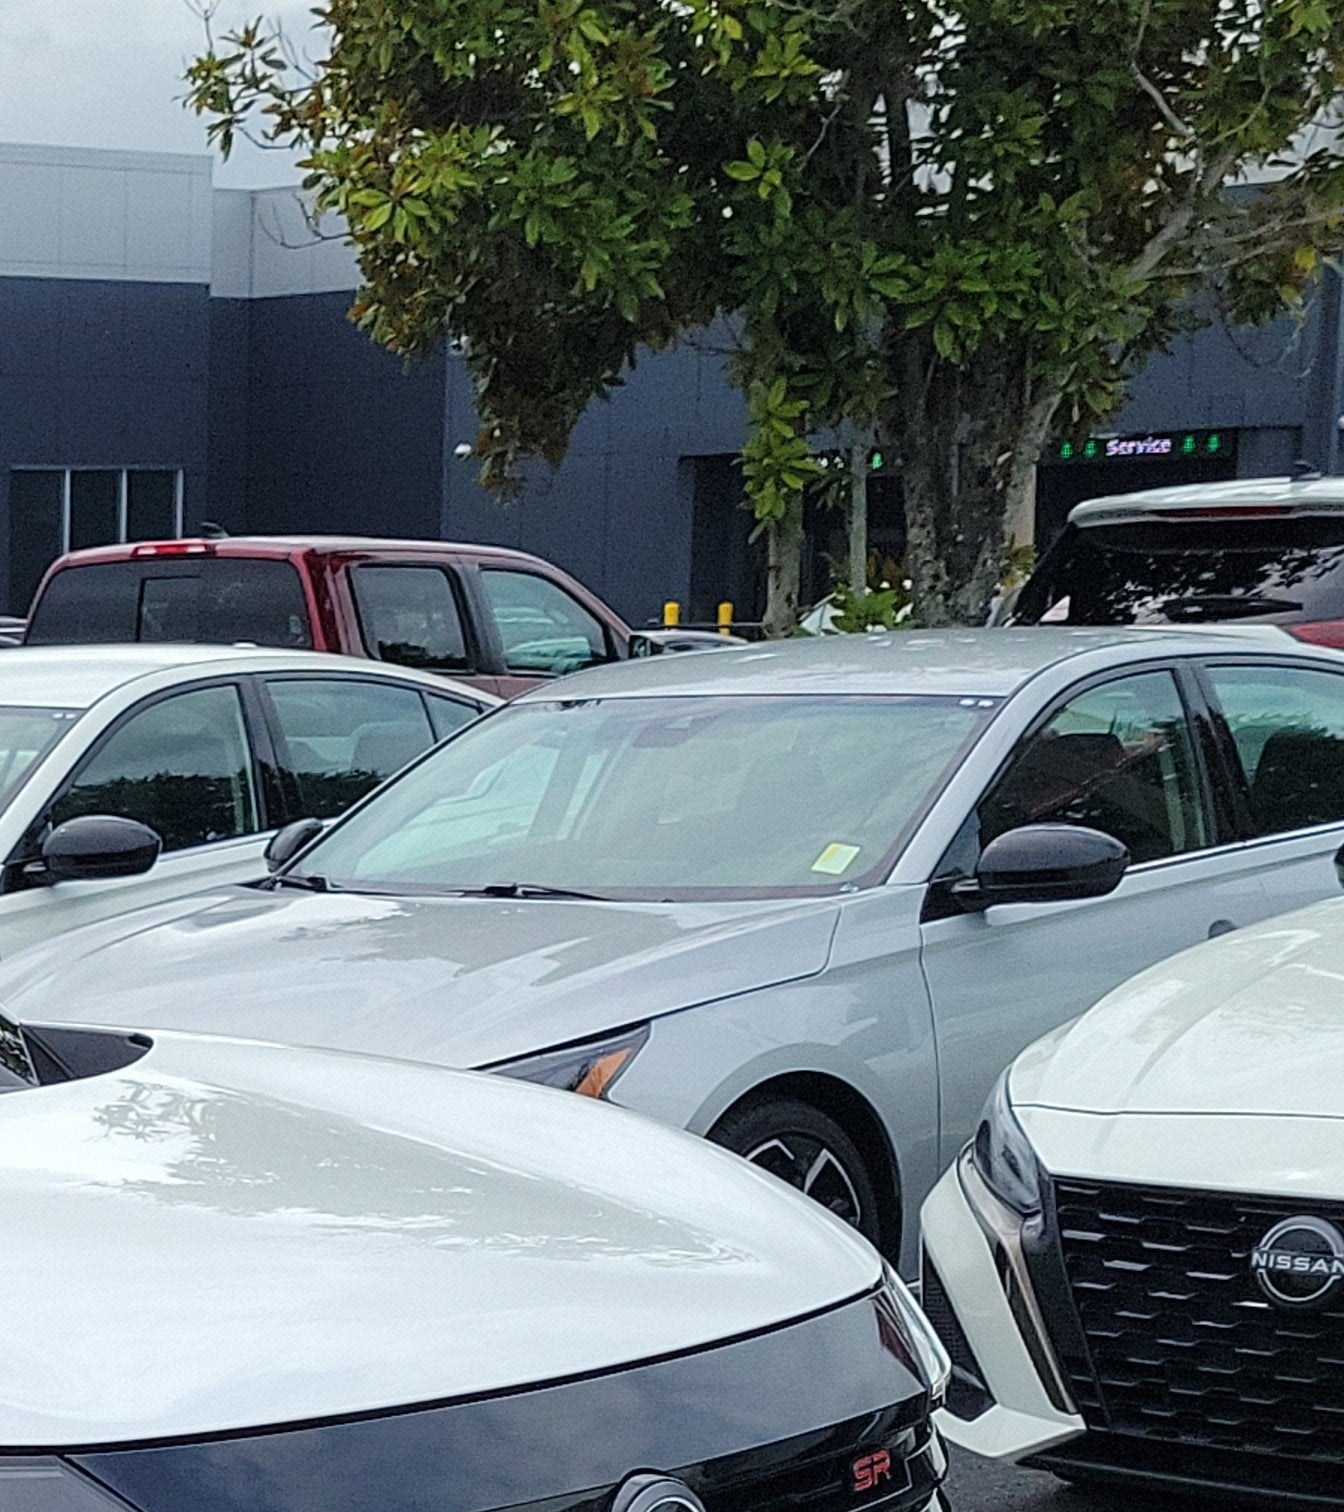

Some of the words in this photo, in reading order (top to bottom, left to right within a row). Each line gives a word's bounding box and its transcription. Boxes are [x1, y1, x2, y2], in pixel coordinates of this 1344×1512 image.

[1104, 436, 1172, 456] Service
[1250, 1251, 1344, 1274] NISSAN
[853, 1449, 892, 1492] SR
